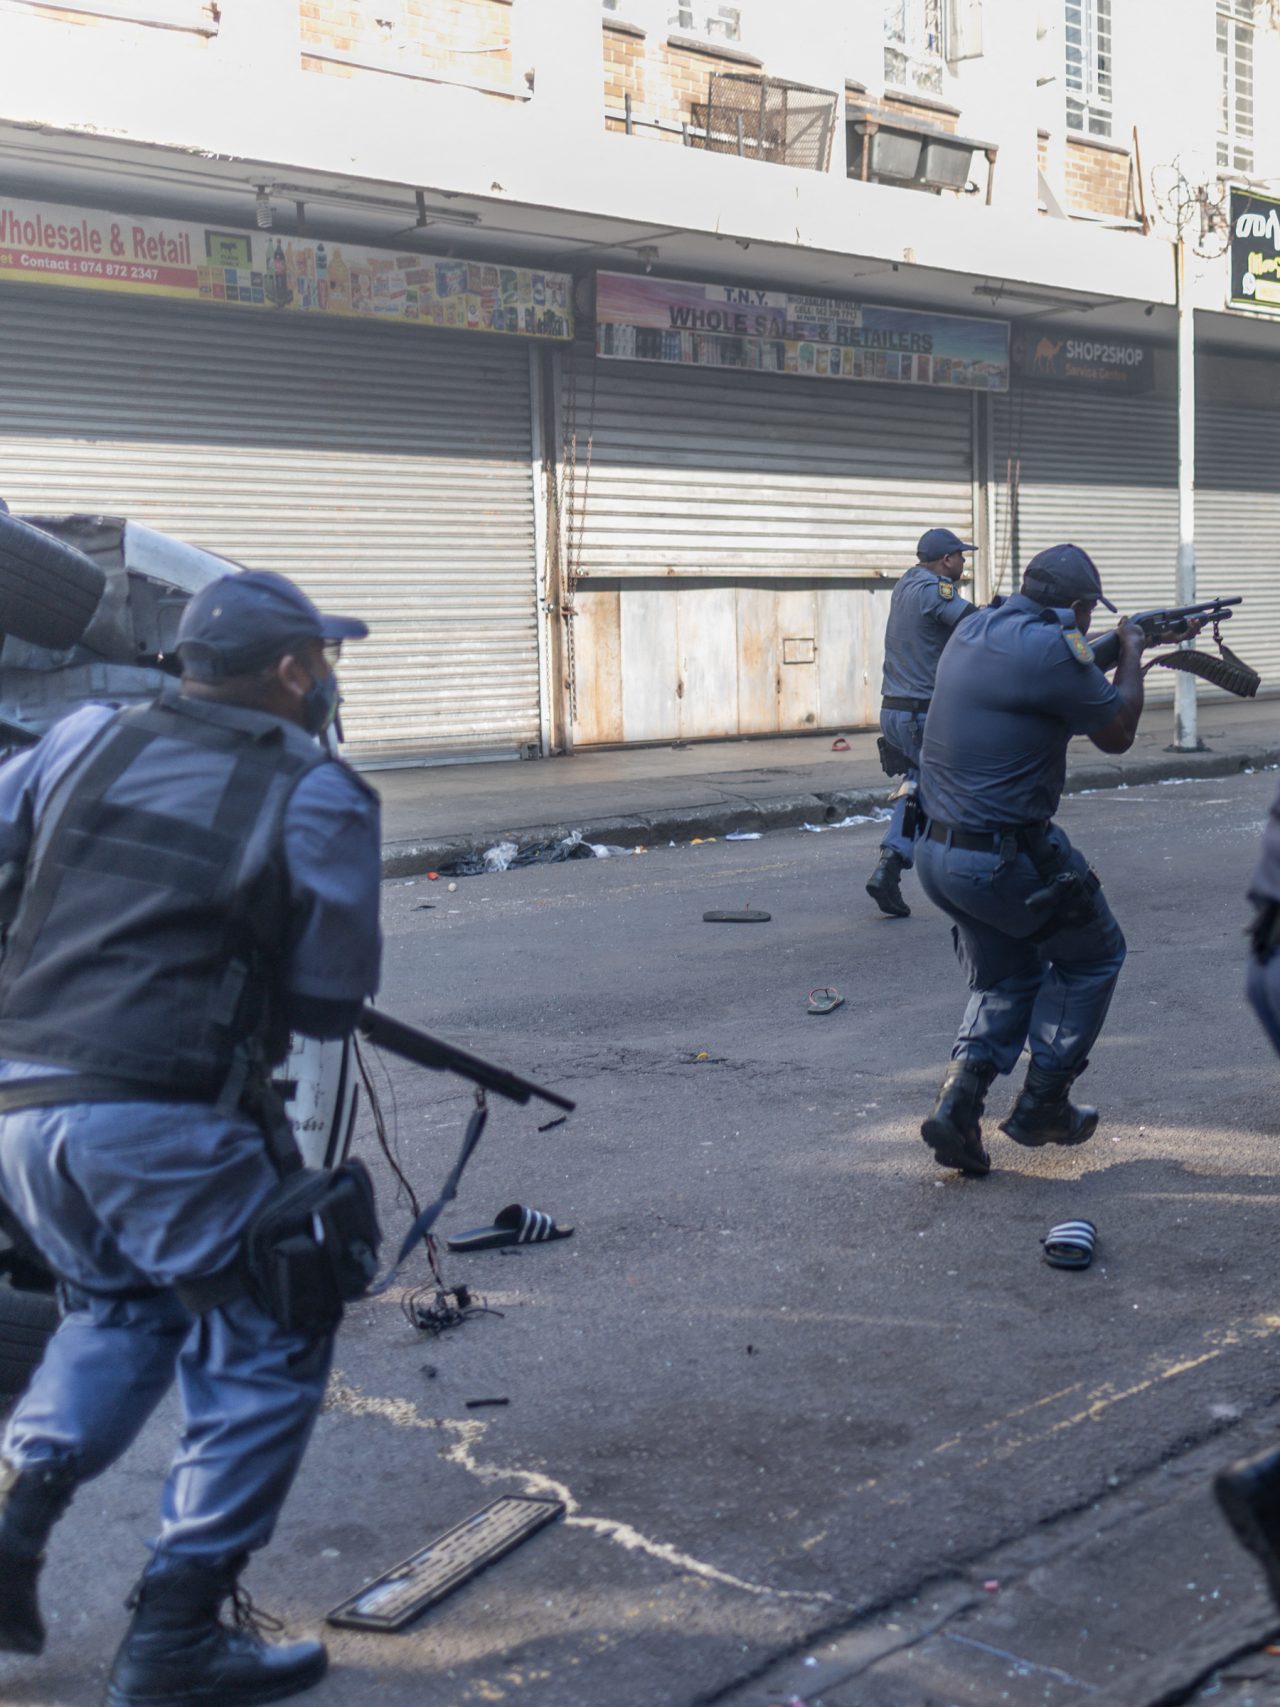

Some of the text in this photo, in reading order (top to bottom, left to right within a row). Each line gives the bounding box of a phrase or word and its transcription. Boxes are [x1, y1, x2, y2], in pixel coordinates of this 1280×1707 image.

[110, 224, 126, 256] &
[132, 226, 192, 264] Retail
[20, 253, 70, 271] Contact
[80, 261, 103, 275] 074
[106, 264, 128, 277] 872
[131, 266, 159, 281] 2347
[723, 288, 769, 306] T.N.Y.
[669, 305, 935, 353] WHOLE SALE & RETAILERS
[1065, 339, 1143, 366] SHOP2SHOP
